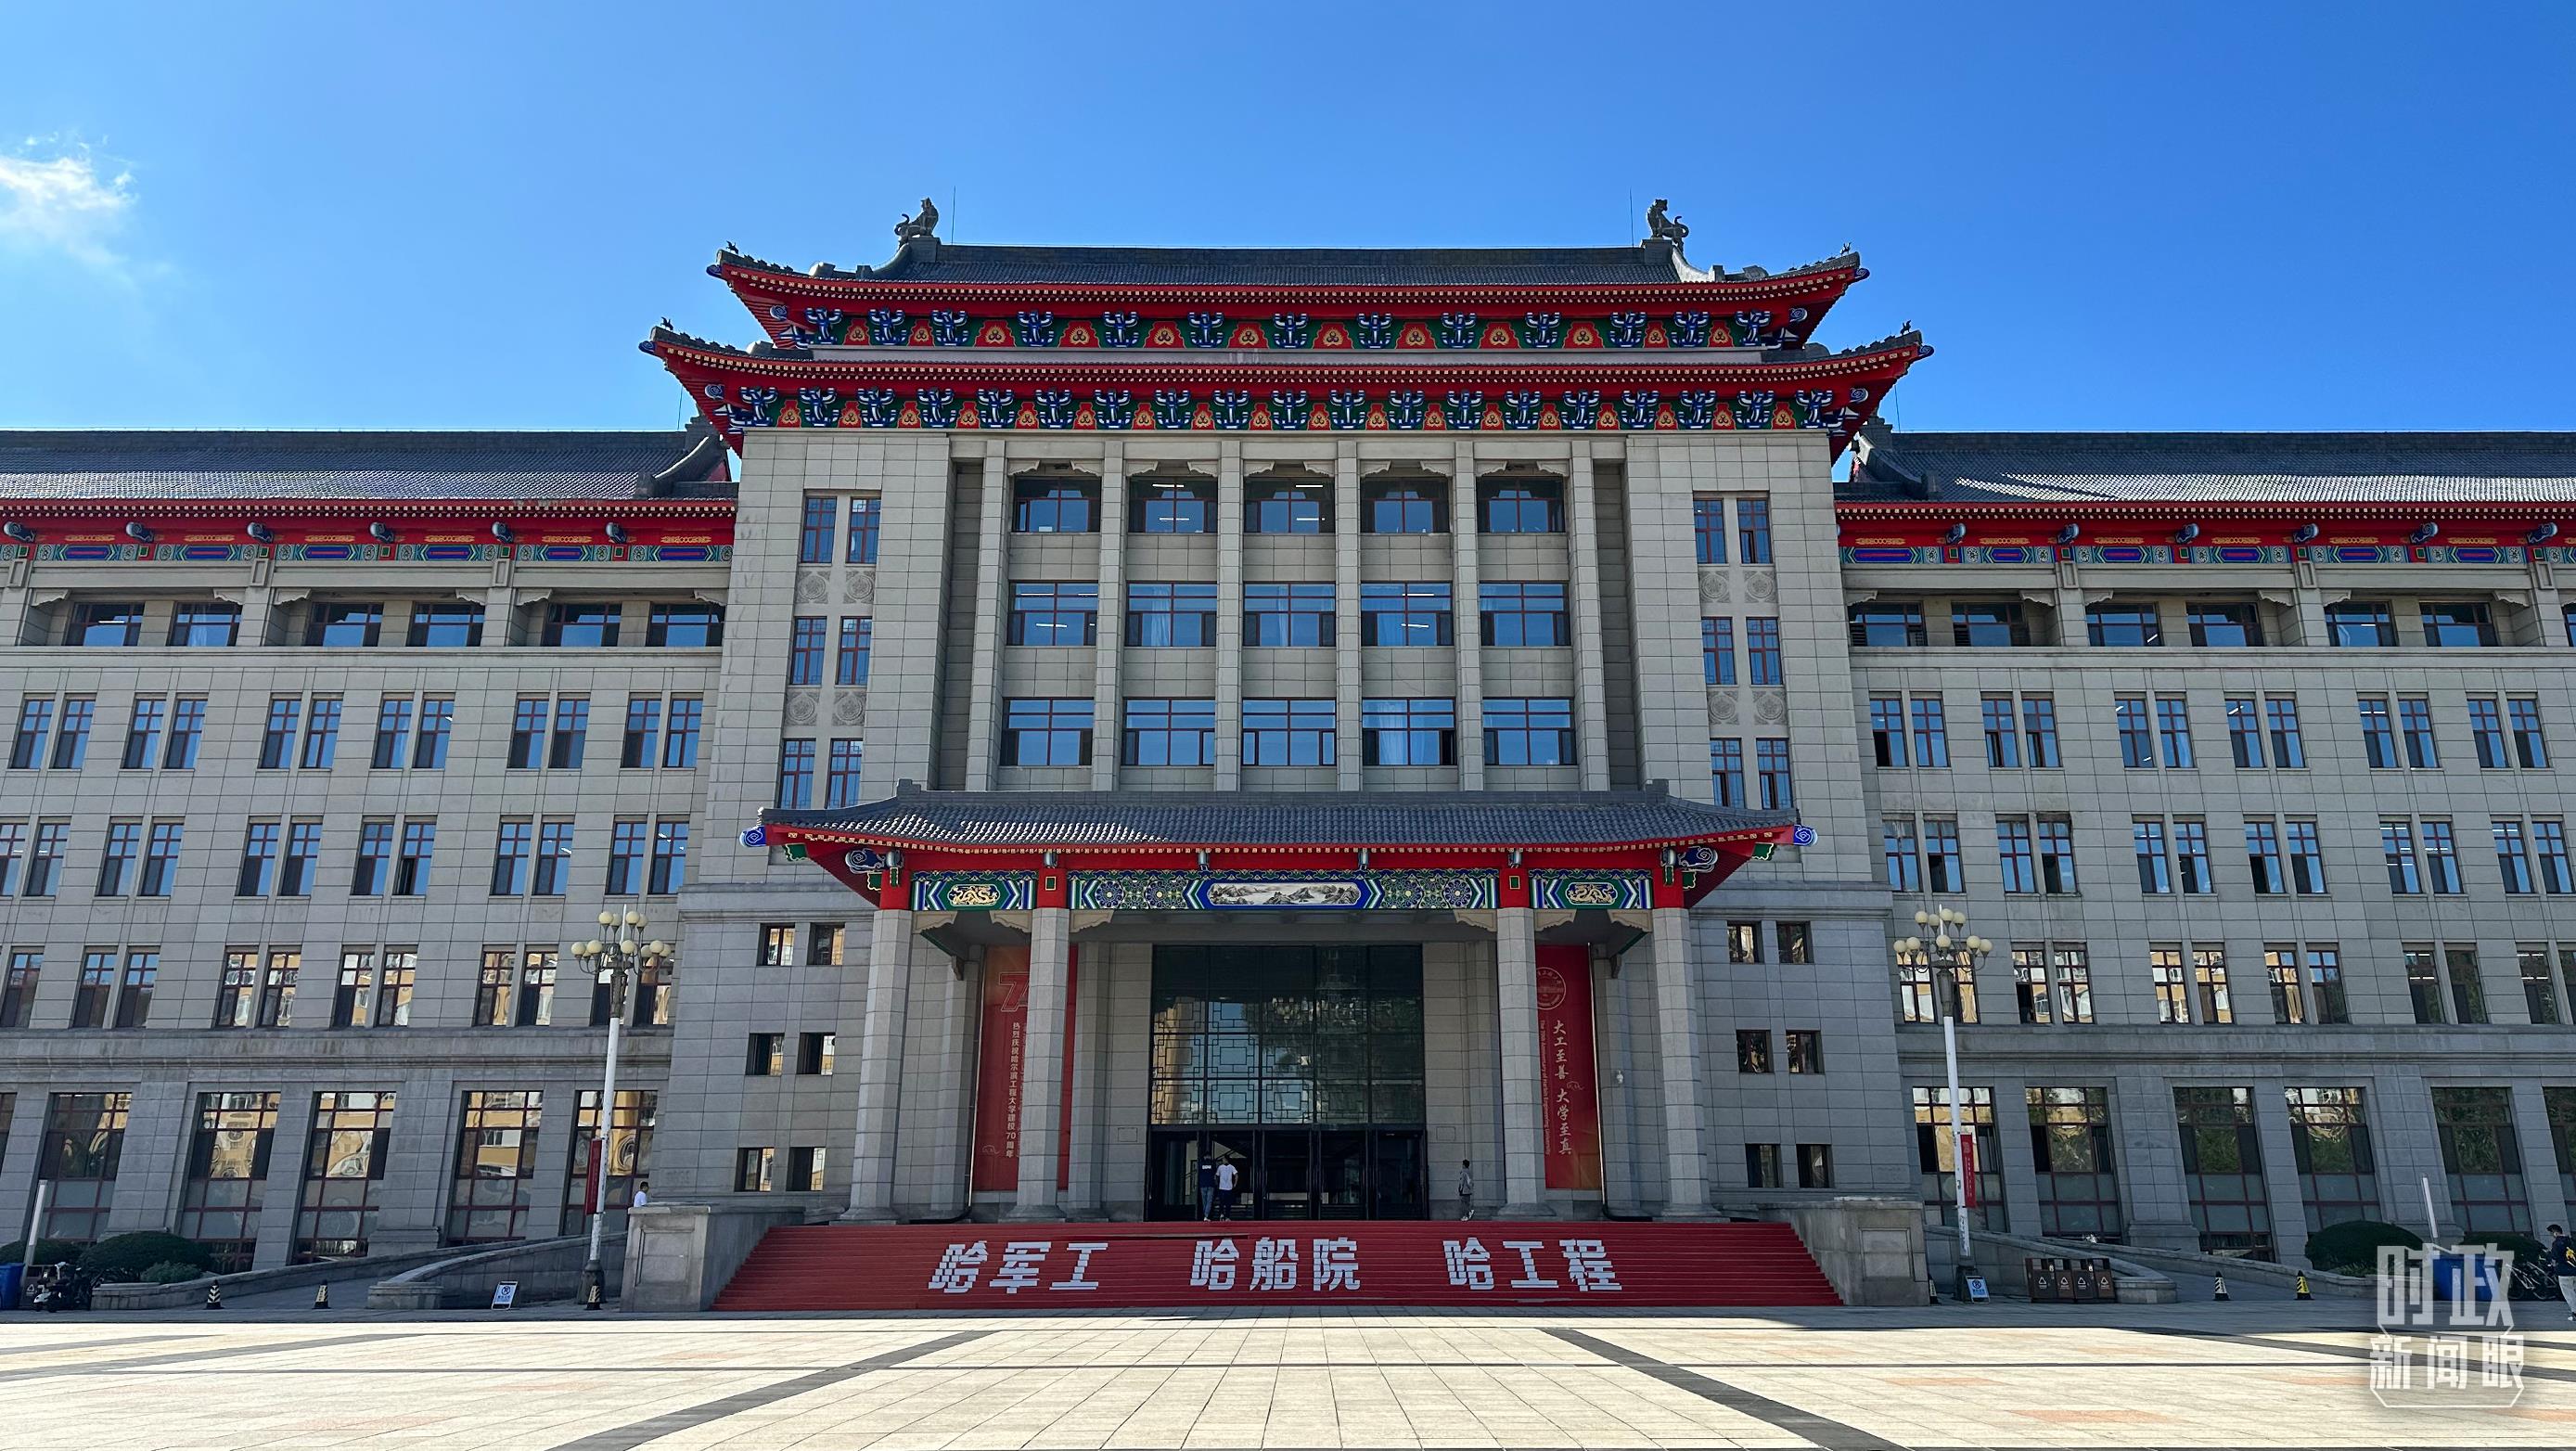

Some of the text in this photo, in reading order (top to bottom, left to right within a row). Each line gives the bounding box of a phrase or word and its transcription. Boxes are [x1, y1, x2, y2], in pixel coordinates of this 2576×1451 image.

[999, 971, 1029, 1012] 7
[1553, 1020, 1572, 1155] 大工至善 大学至真
[928, 1237, 1622, 1294] 哈军工 哈船院 哈工程
